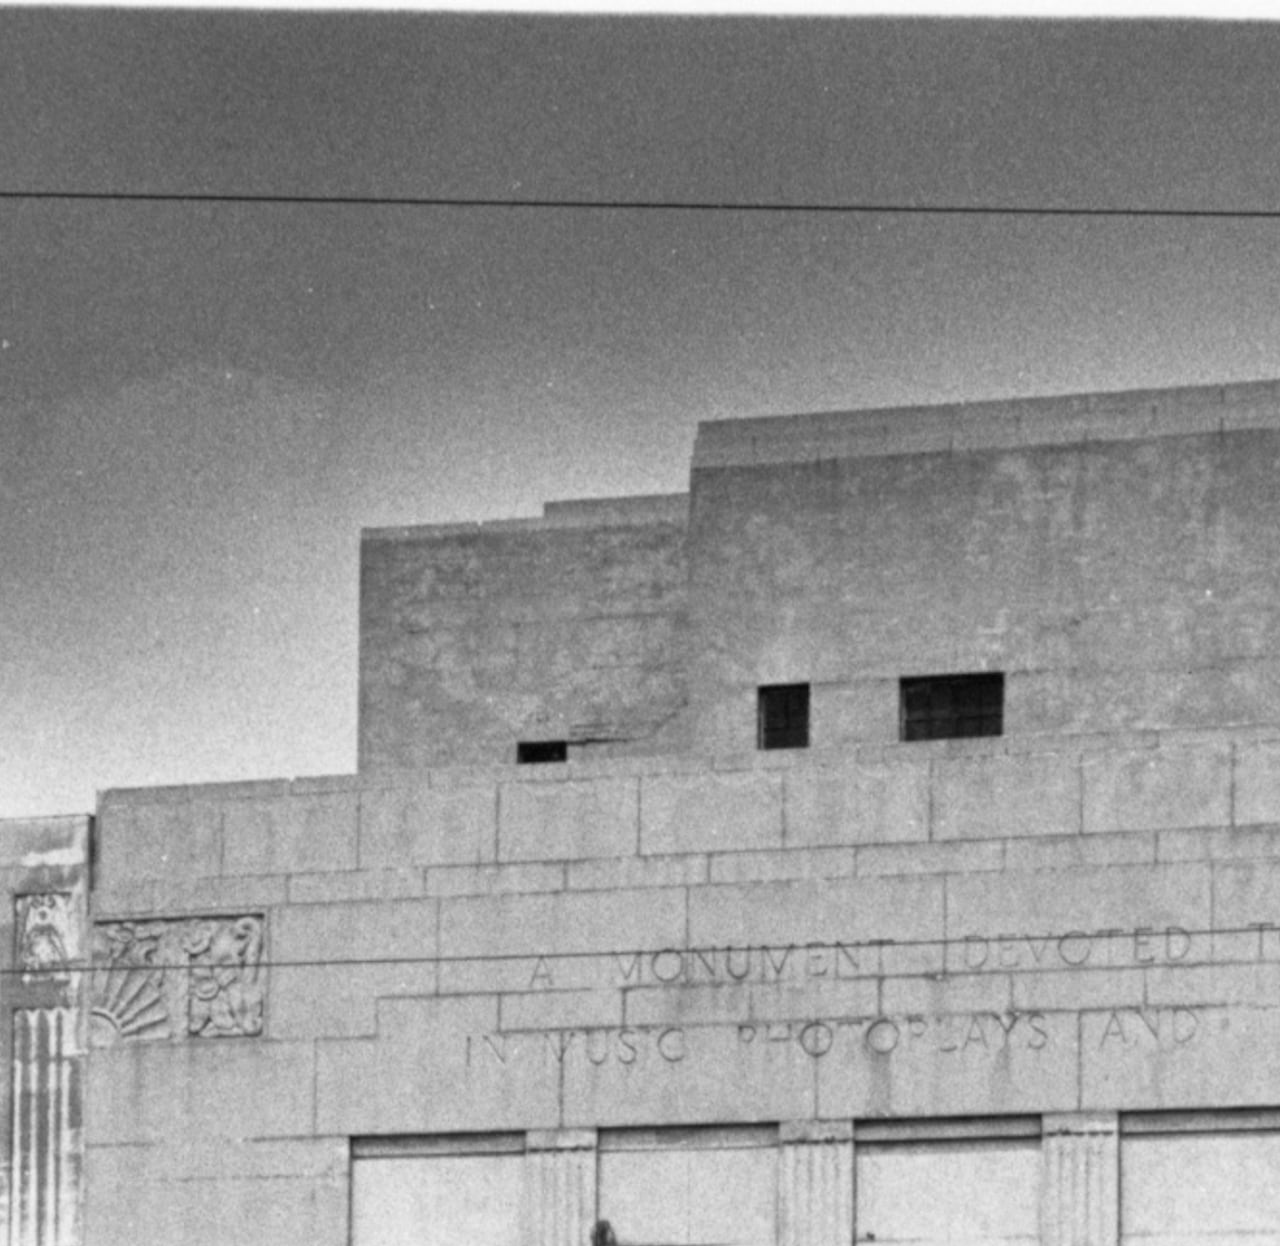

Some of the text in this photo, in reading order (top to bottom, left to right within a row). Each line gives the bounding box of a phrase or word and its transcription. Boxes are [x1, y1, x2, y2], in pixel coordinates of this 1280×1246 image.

[528, 952, 554, 988] A
[616, 941, 896, 983] MONUMENT
[963, 926, 1192, 969] DEVOTED
[464, 1033, 507, 1068] IN
[1098, 1008, 1199, 1050] AND
